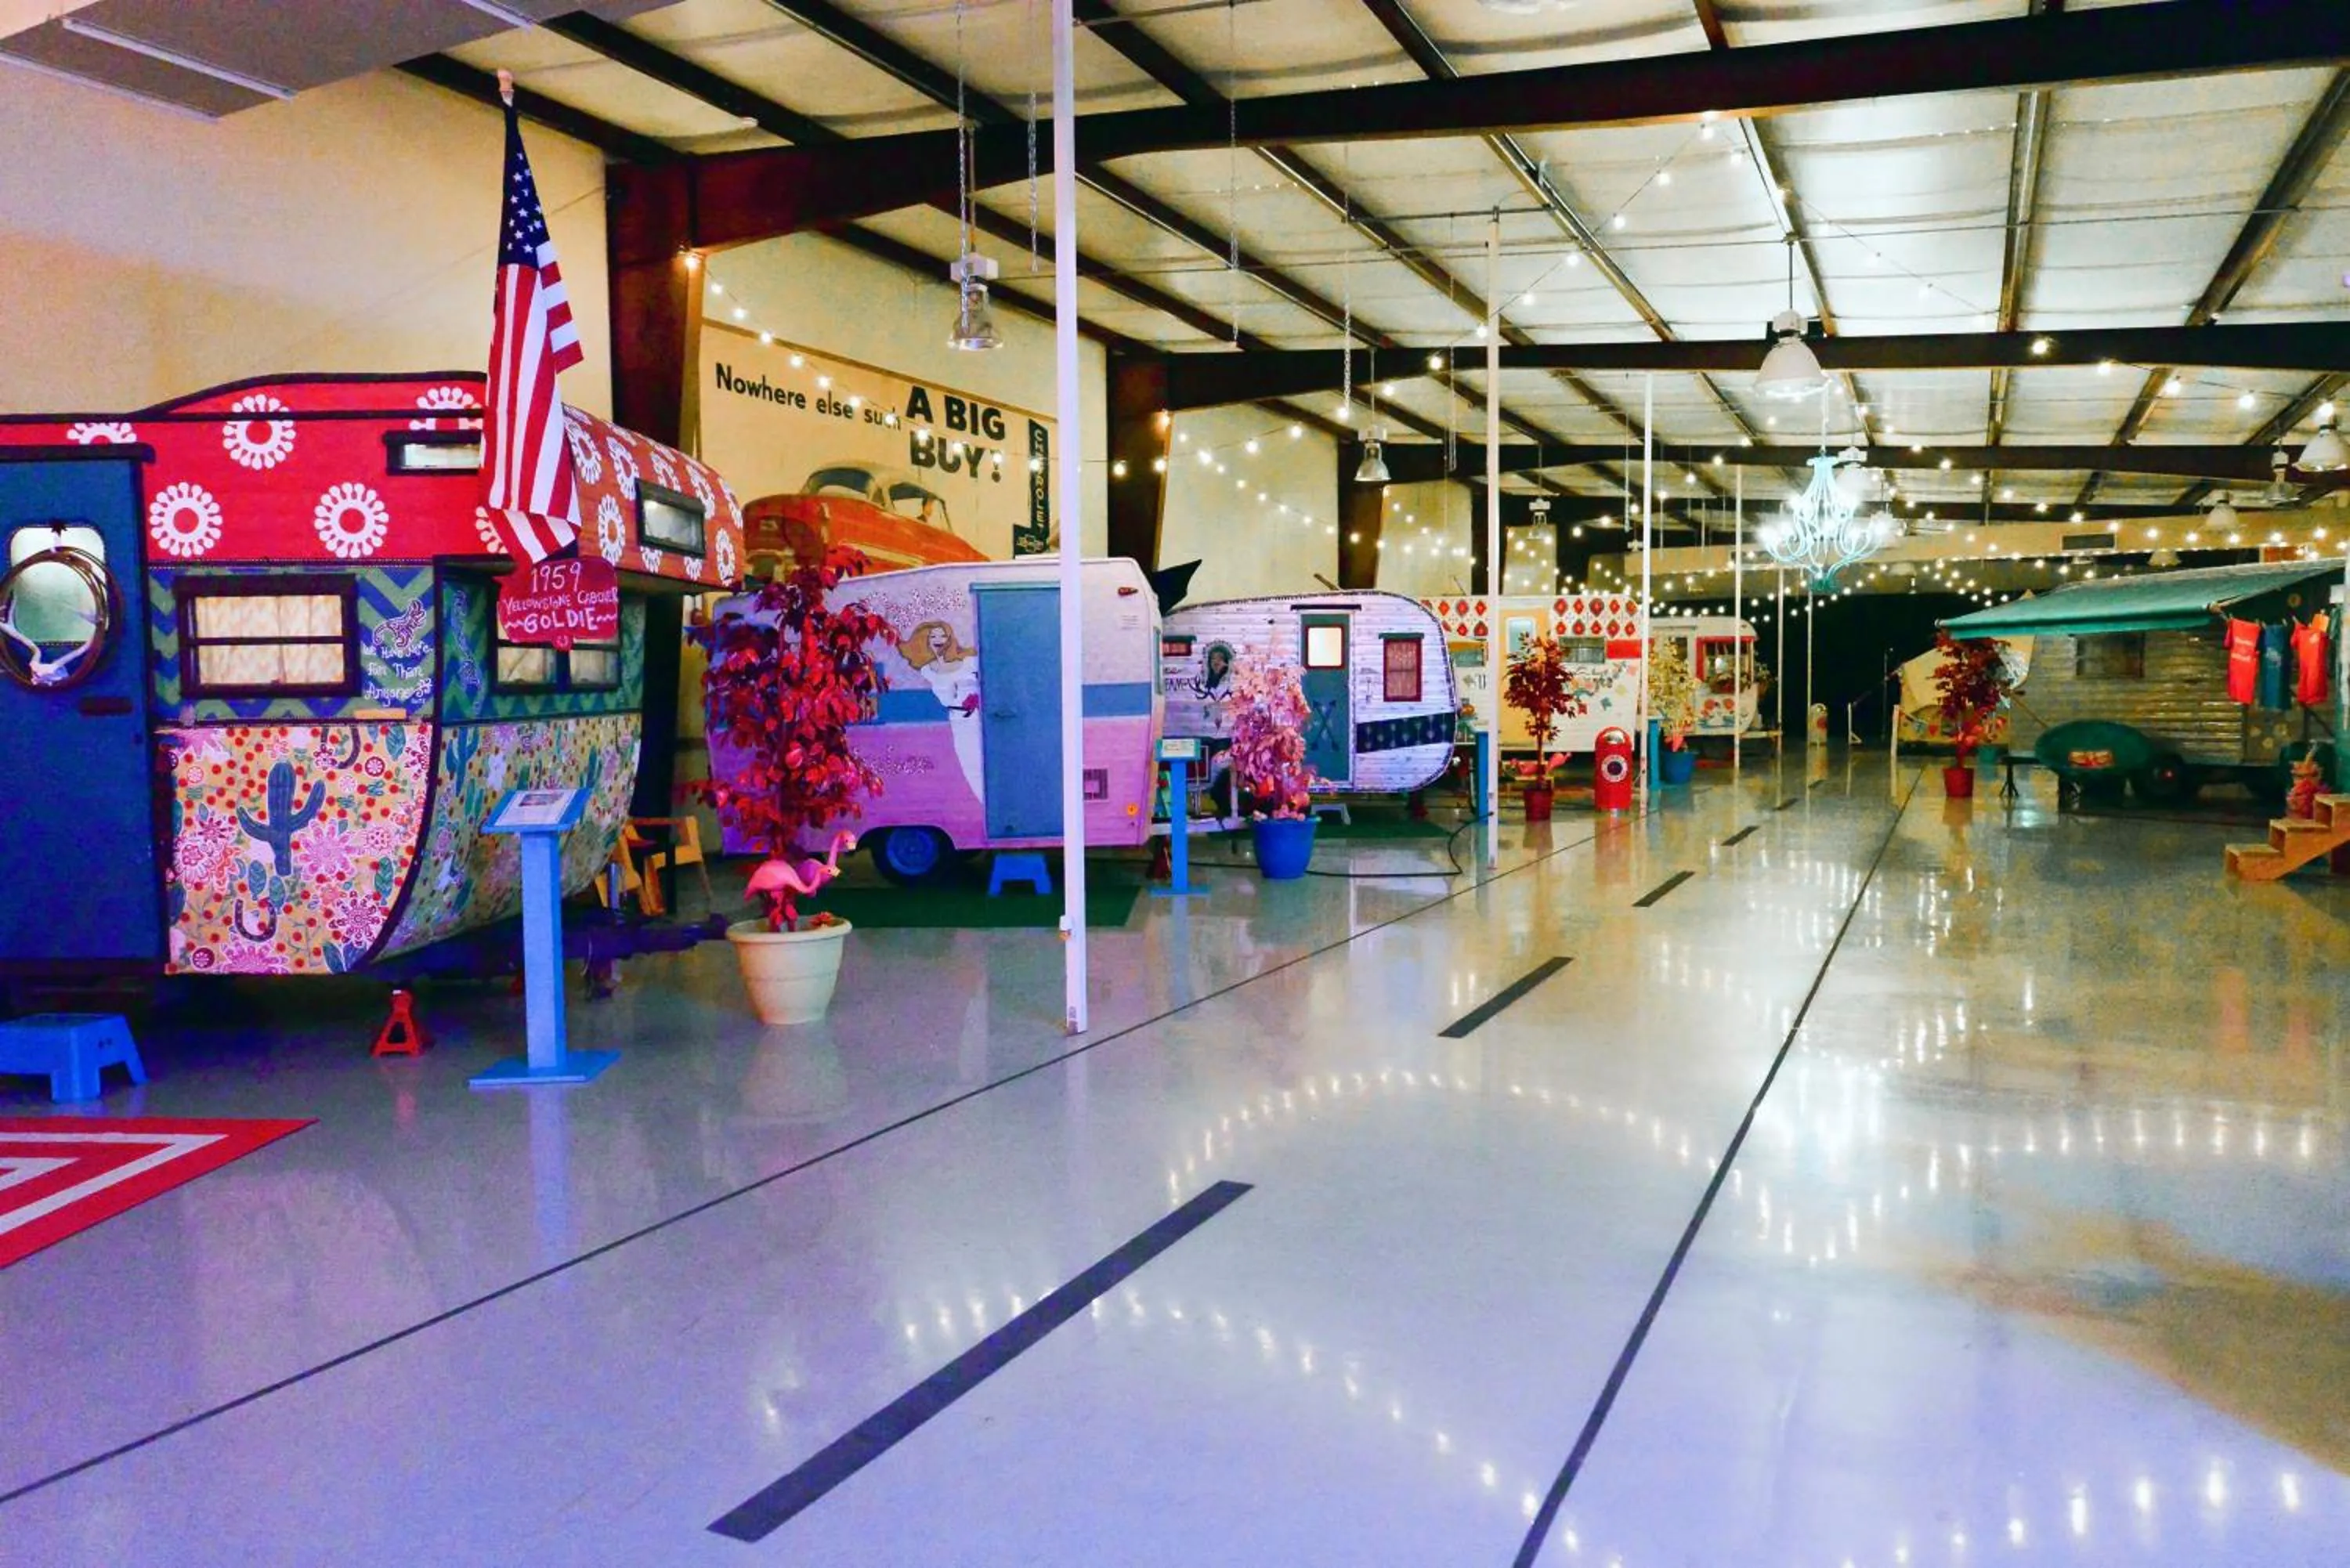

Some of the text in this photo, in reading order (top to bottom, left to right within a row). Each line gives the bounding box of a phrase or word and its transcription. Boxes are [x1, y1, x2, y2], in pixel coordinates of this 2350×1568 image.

[715, 362, 806, 409] Nowhere
[815, 391, 853, 419] else
[905, 385, 1005, 441] A BIG
[909, 430, 1001, 483] BUY!
[530, 562, 581, 593] 1959
[523, 606, 599, 634] GOLDIE
